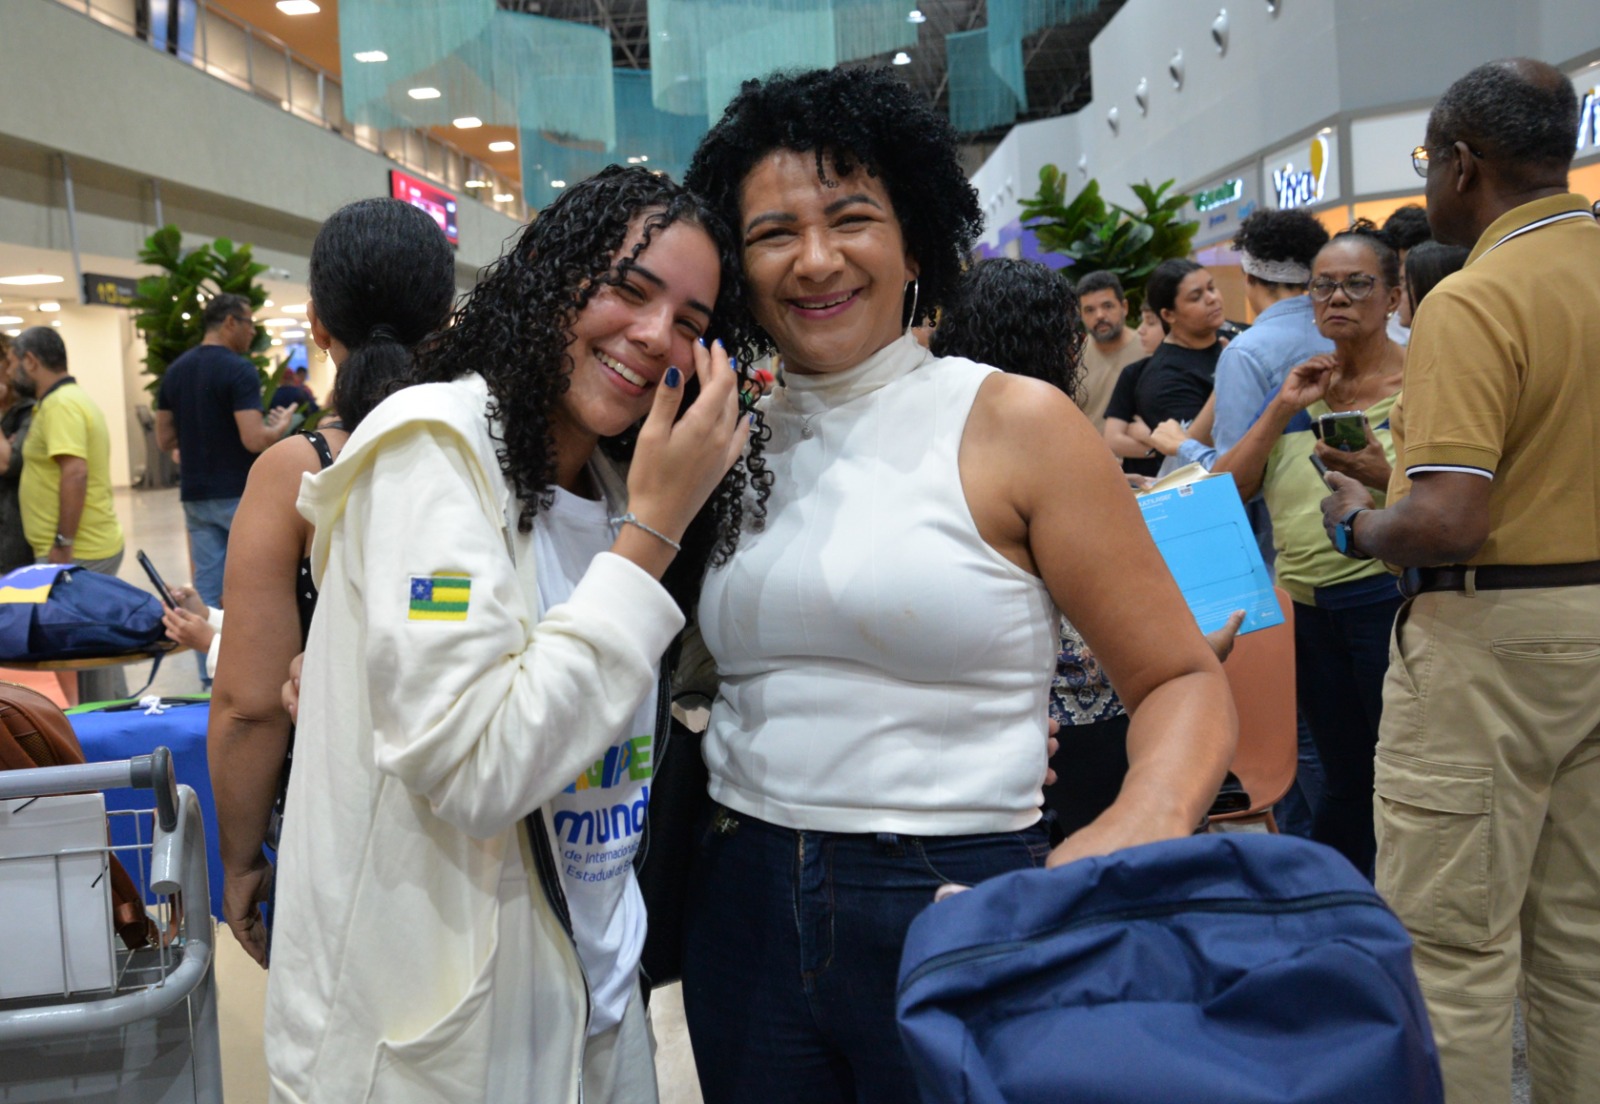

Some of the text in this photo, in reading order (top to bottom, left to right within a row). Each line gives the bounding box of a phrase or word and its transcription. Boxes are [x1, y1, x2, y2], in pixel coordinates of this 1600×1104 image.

[553, 785, 650, 846] mund
[564, 850, 583, 863] de
[566, 864, 616, 882] Estadual
